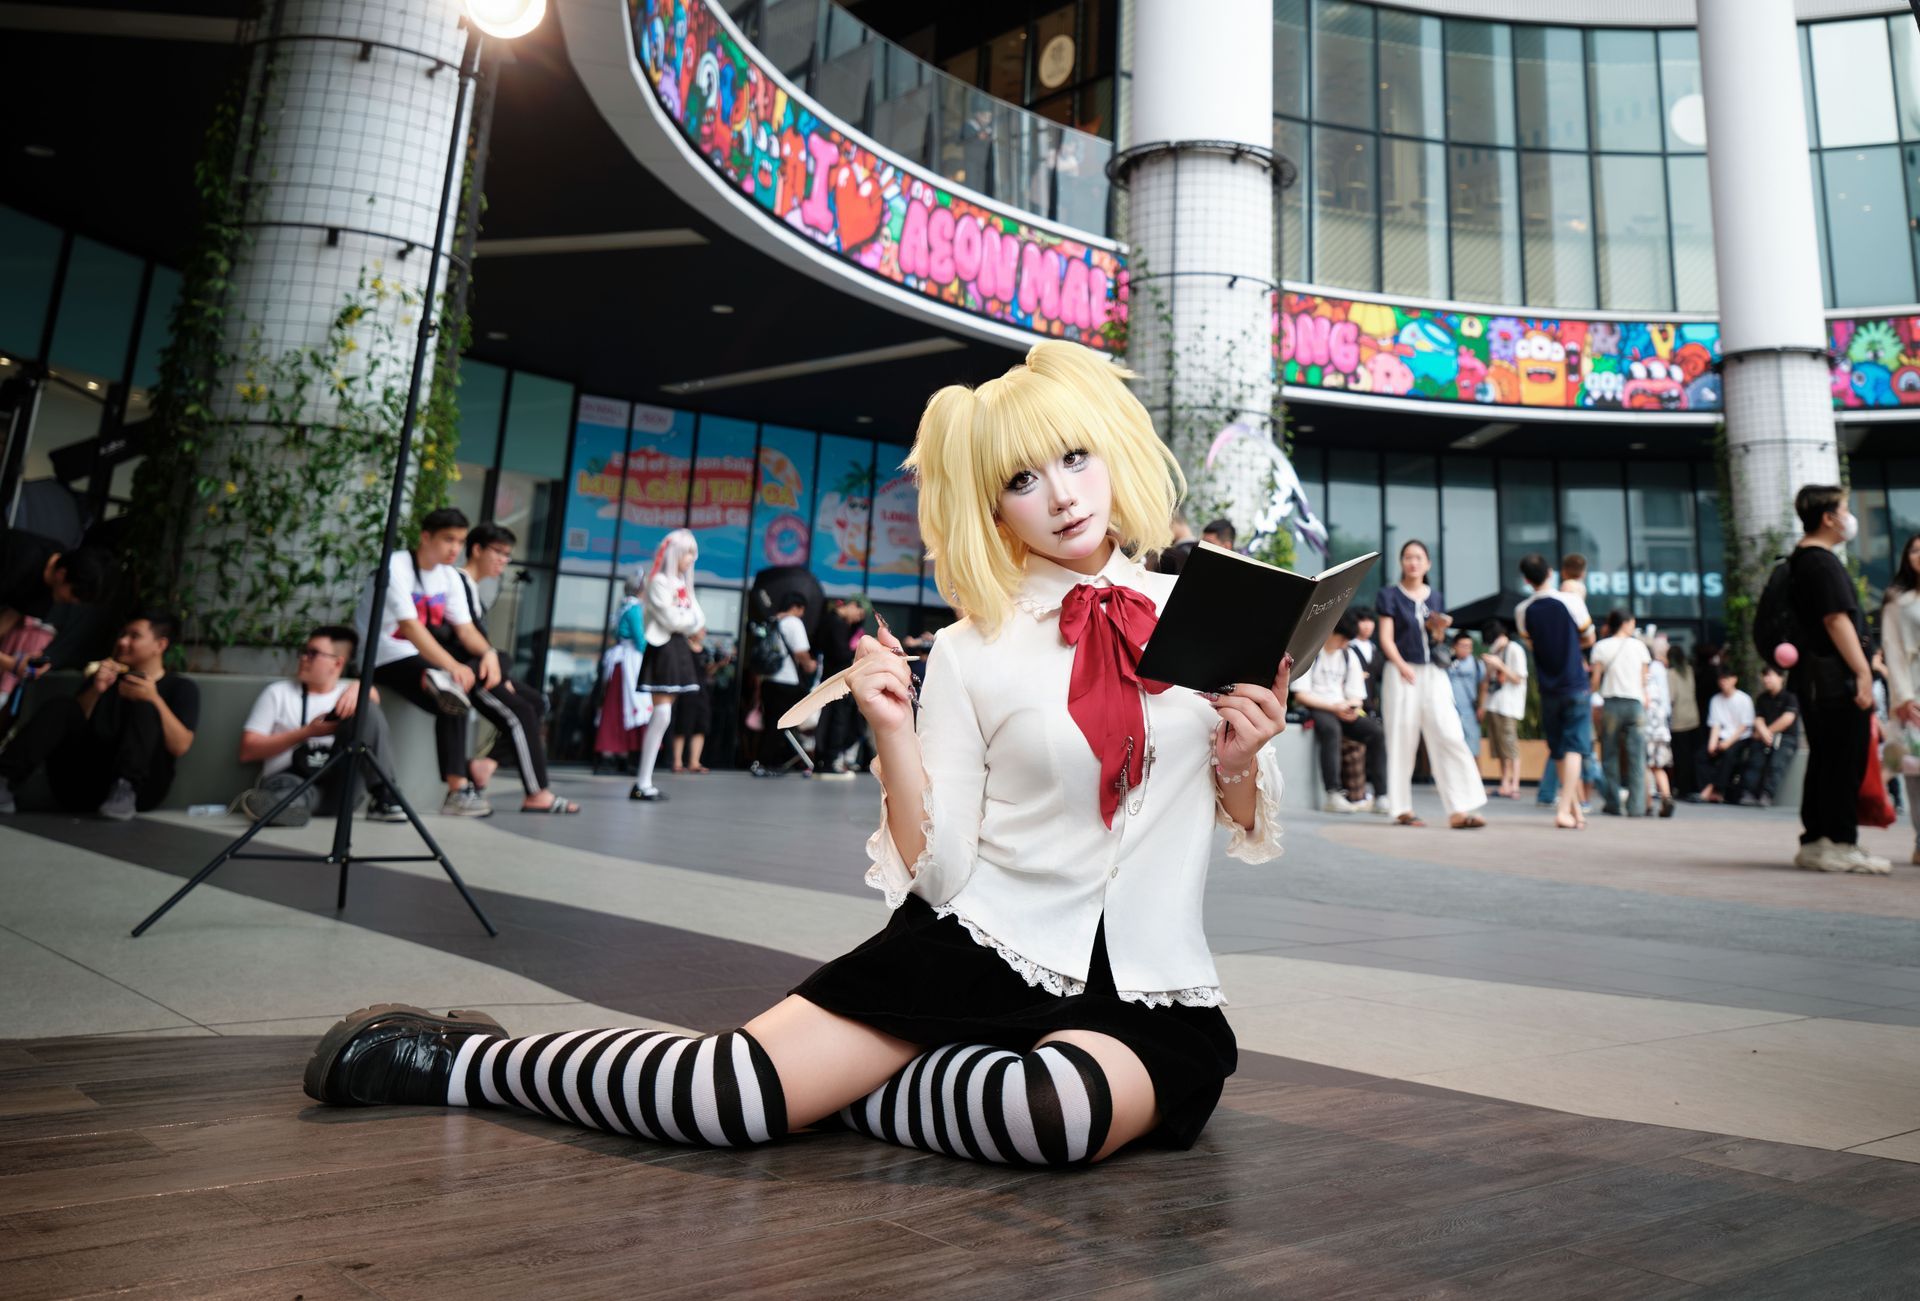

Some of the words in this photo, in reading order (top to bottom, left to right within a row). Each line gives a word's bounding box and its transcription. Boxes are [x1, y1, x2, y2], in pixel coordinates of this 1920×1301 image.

[802, 132, 839, 233] I
[899, 199, 1020, 303] AEON
[1019, 241, 1129, 331] MAL
[1272, 312, 1360, 374] ONG
[1519, 571, 1724, 597] RBUCKS
